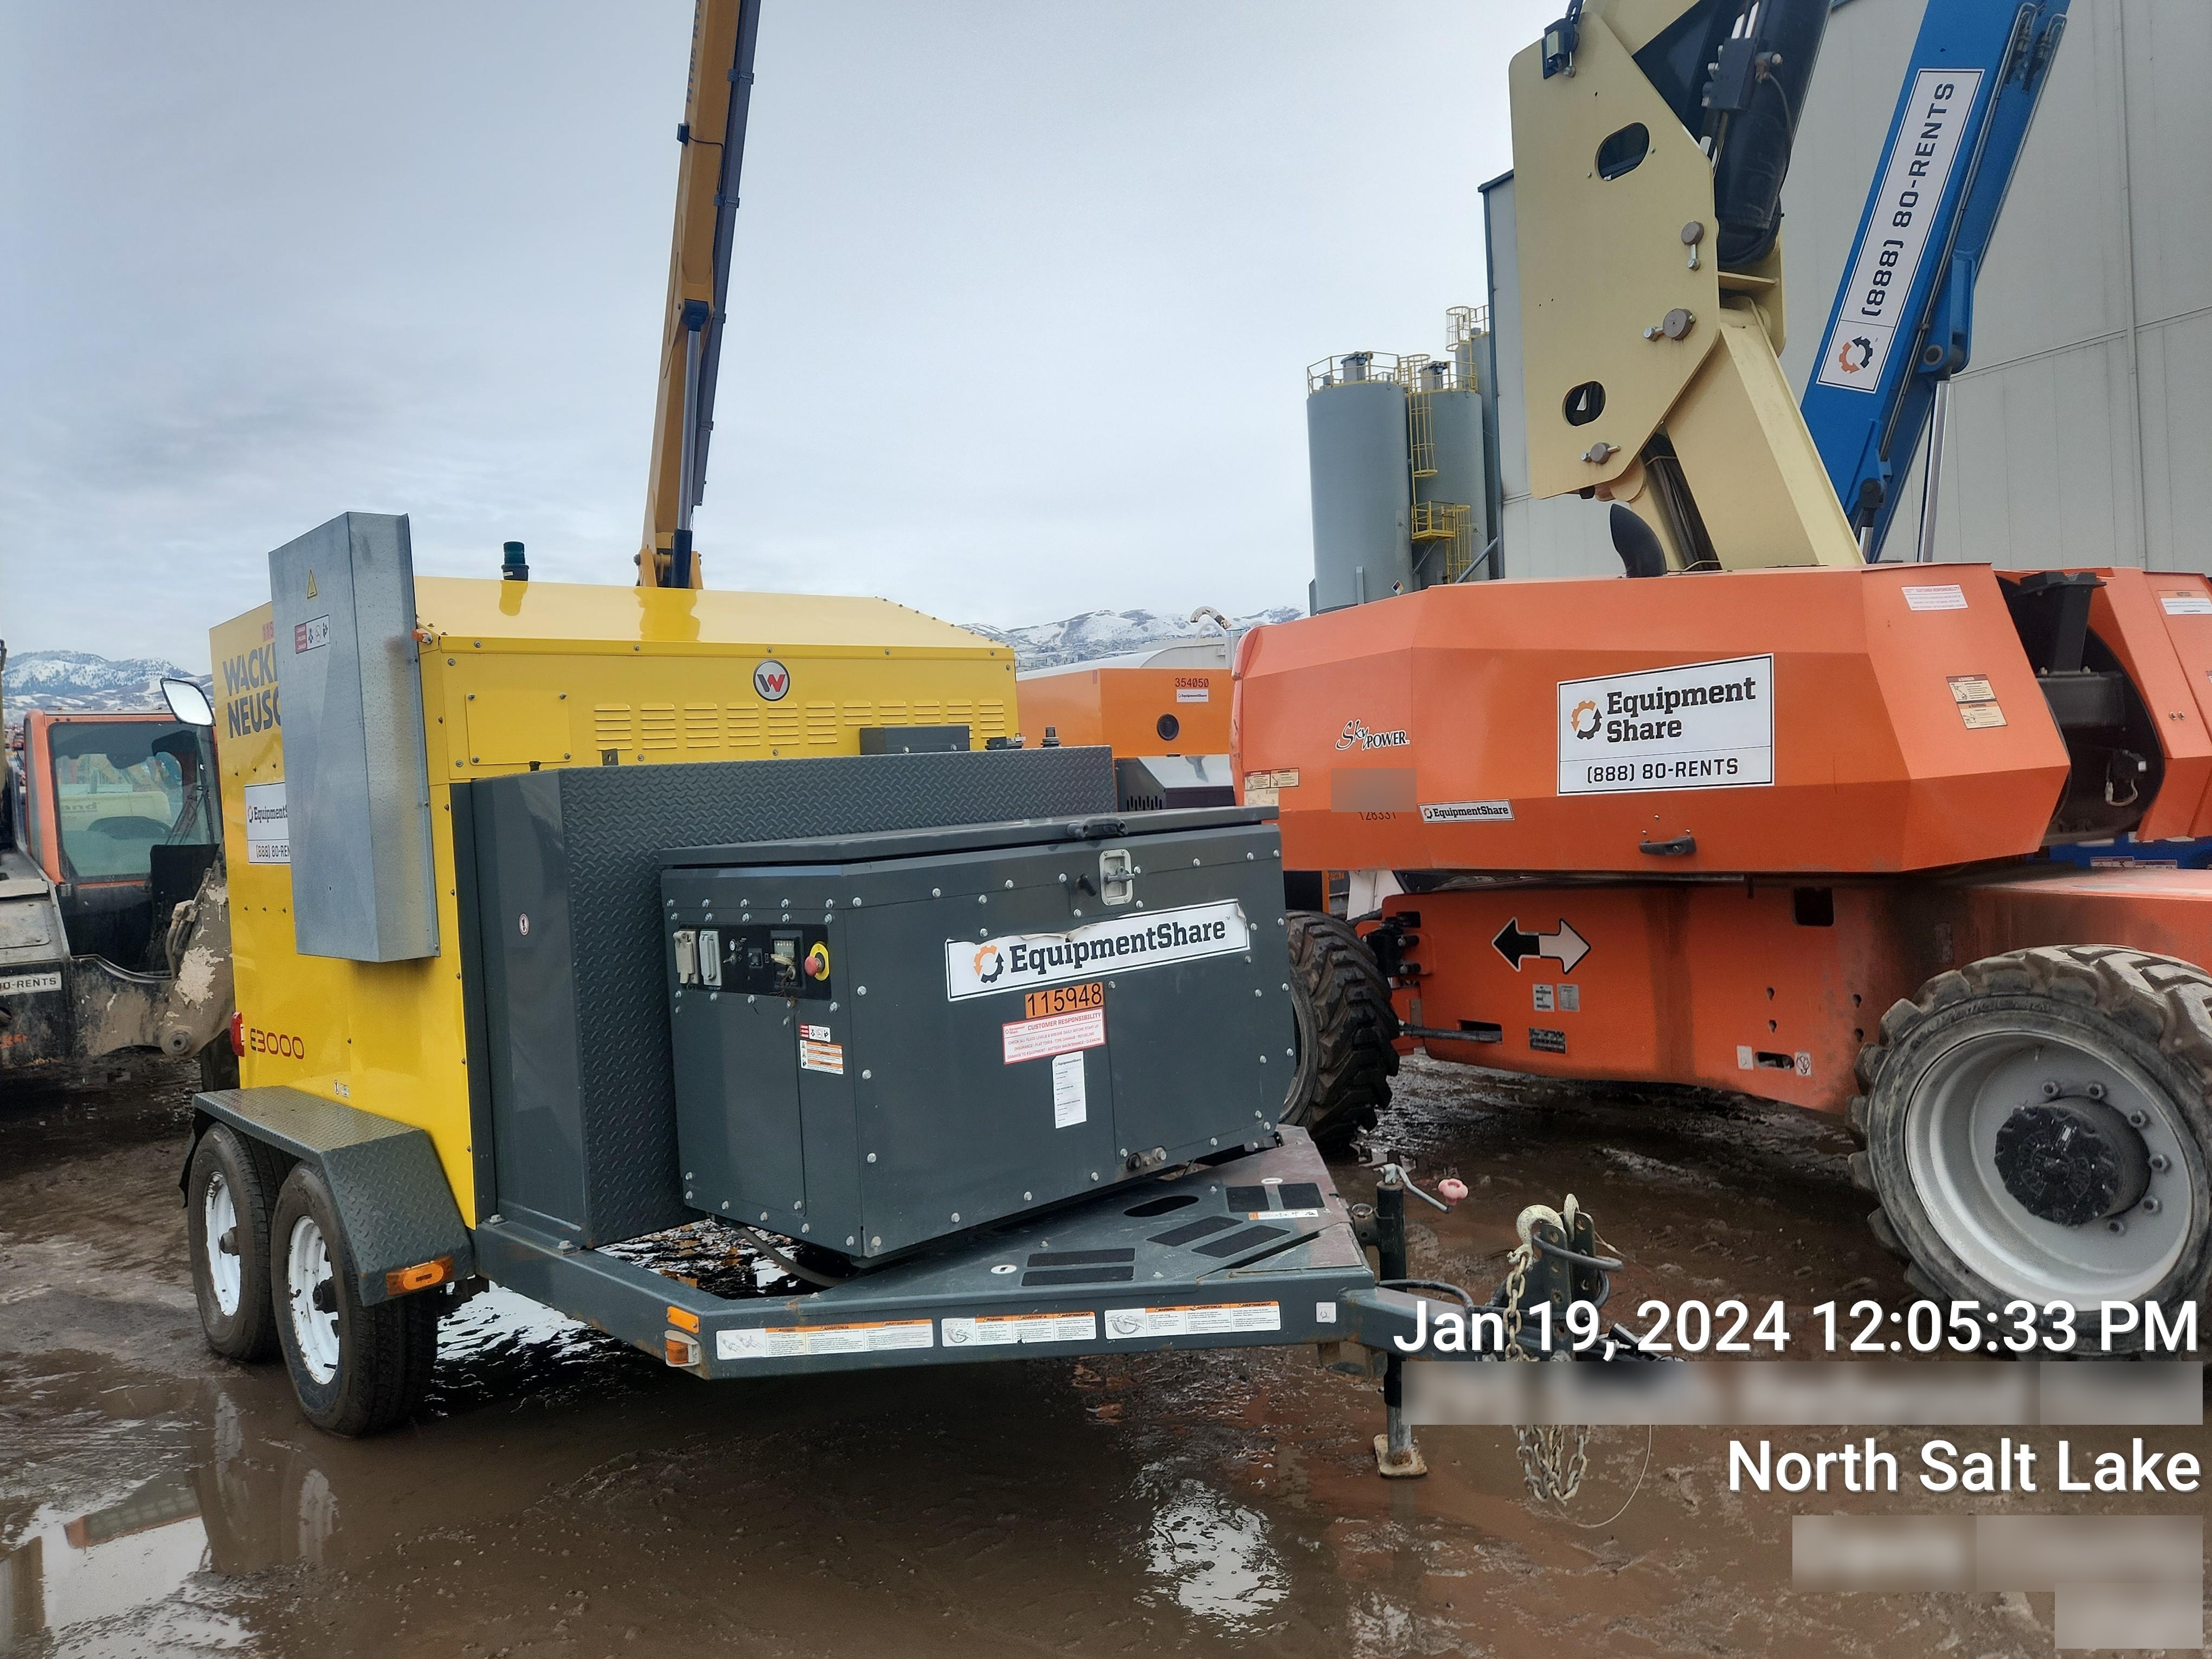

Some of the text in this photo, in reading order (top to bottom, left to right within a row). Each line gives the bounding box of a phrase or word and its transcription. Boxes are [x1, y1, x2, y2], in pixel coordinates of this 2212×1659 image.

[1862, 83, 1954, 317] (888) 80-RENTS
[1175, 678, 1209, 687] 354050
[1607, 677, 1756, 718] Equipment
[1607, 719, 1682, 743] Share
[1587, 758, 1738, 784] (888) 80-RENTS
[1432, 806, 1509, 818] EquipmentShare
[256, 845, 270, 858] (888)
[1009, 921, 1225, 975] EquipmentShare
[0, 978, 57, 990] 0-RENTS
[1027, 983, 1102, 1016] 115948
[1028, 1020, 1057, 1031] CUSTOMER
[1058, 1013, 1101, 1025] RESPONSIBILITY
[250, 1028, 304, 1059] E3000
